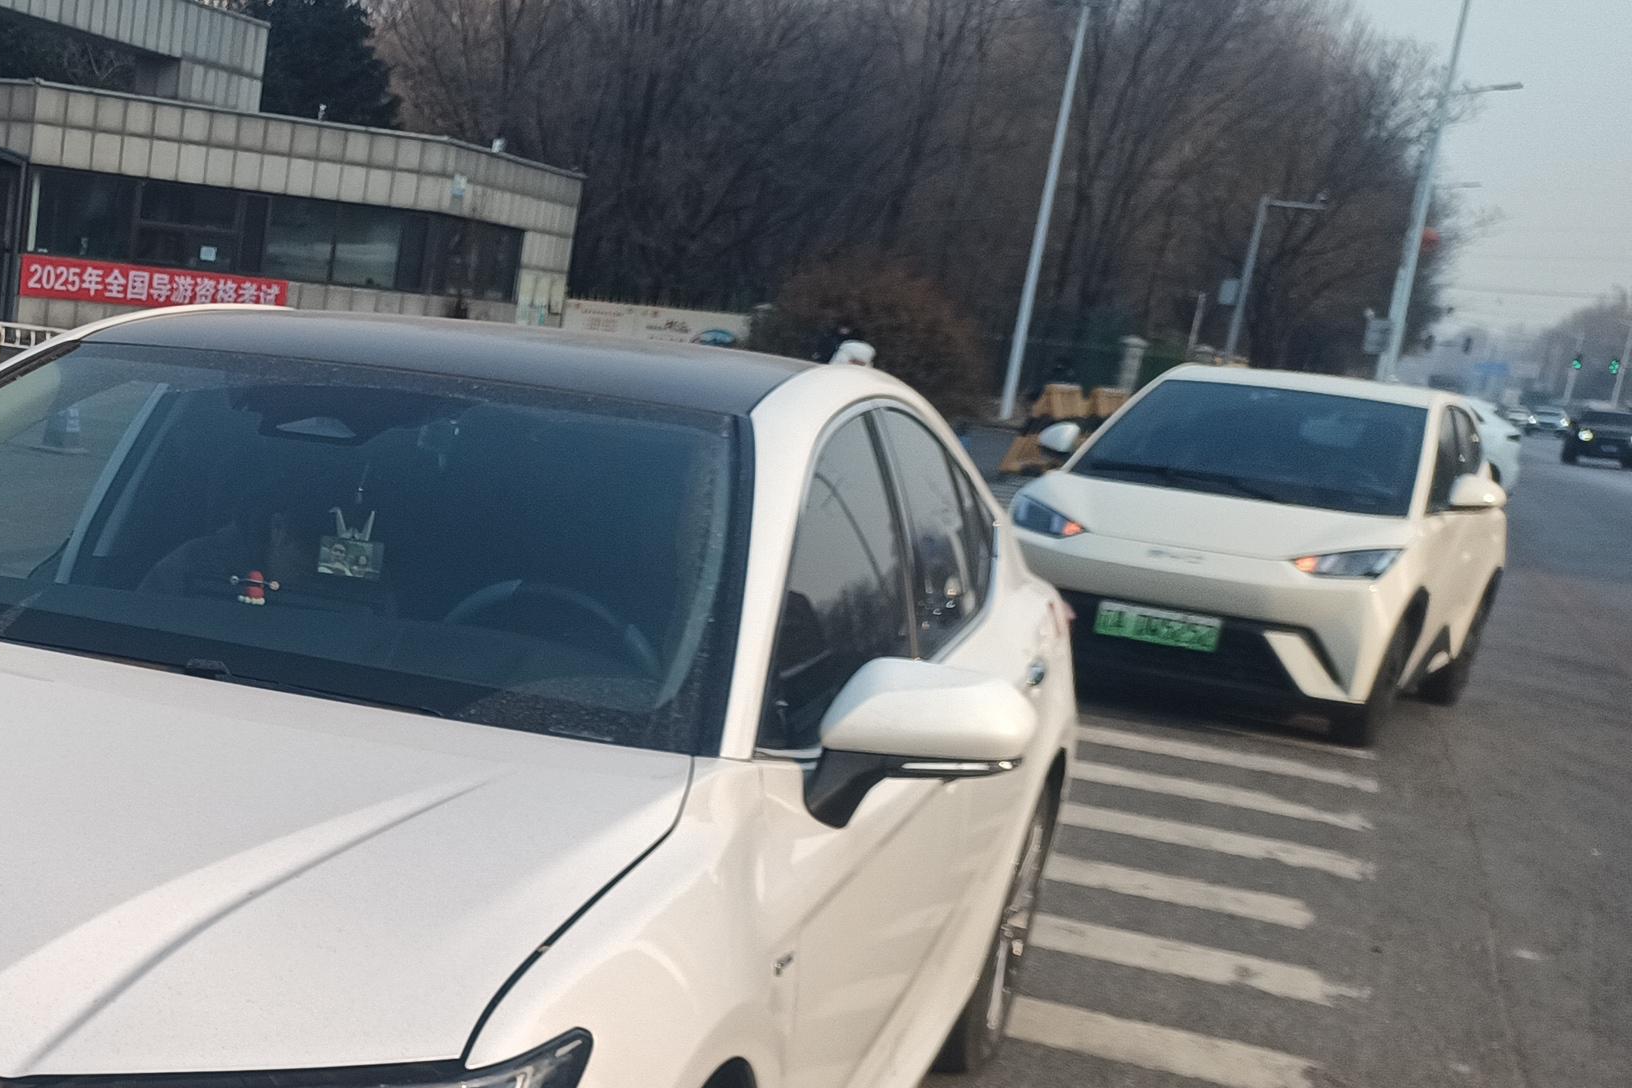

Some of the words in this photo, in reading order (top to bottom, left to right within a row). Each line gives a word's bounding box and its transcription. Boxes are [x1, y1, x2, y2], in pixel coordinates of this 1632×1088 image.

[27, 263, 281, 305] 2025年全国导游资格考试
